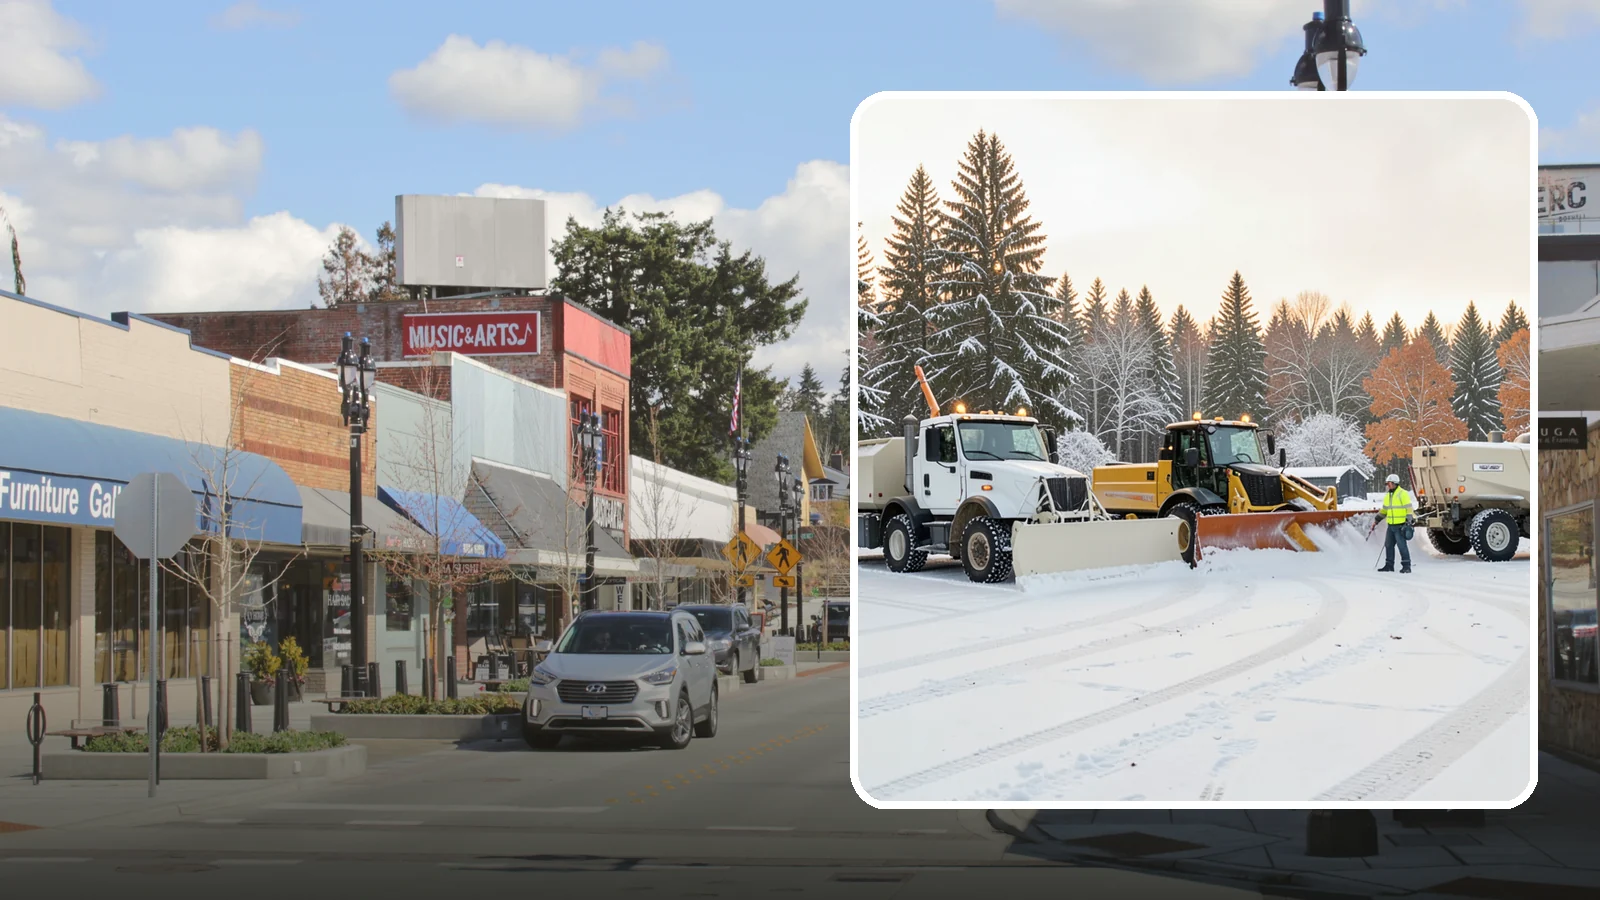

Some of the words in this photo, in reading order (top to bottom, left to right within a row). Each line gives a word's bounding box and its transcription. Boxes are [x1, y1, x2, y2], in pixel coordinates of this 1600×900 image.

[409, 323, 520, 349] MUSIC&ARTS
[0, 471, 79, 516] Furniture
[89, 482, 122, 519] Gal
